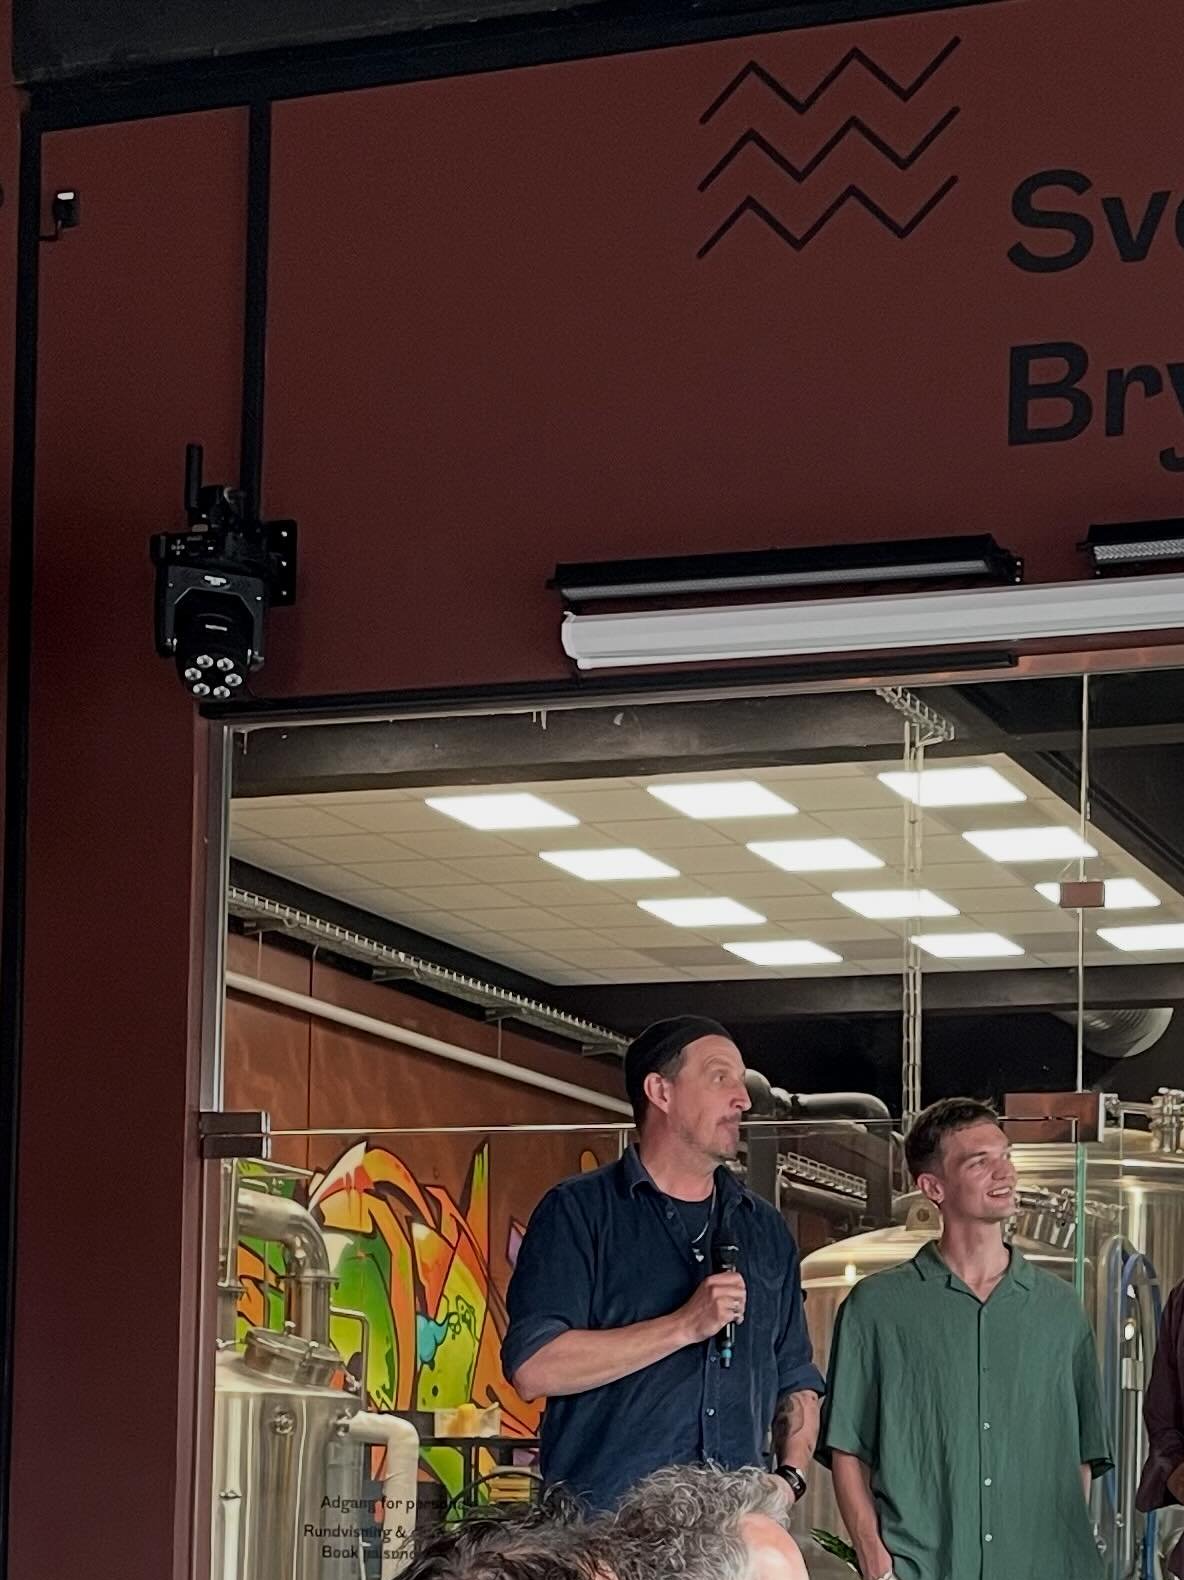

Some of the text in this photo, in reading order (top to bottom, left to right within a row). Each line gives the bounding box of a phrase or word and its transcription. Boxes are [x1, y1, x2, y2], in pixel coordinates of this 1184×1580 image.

[320, 1495, 376, 1514] Adgang
[381, 1495, 403, 1510] for
[395, 1525, 406, 1538] &
[321, 1545, 359, 1559] Book
